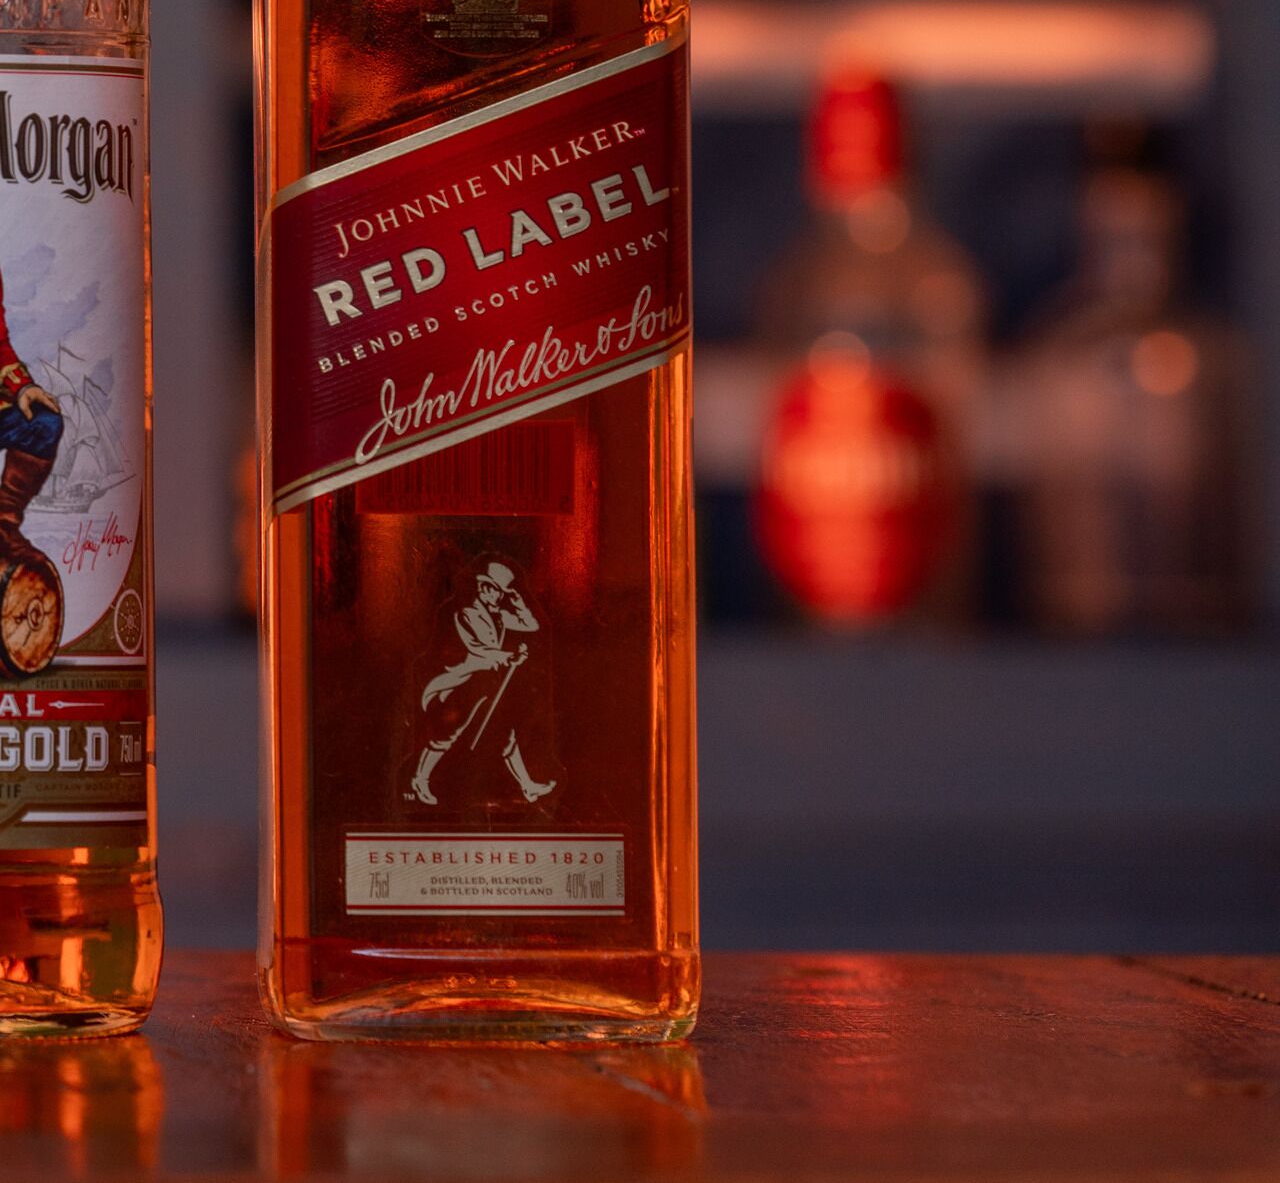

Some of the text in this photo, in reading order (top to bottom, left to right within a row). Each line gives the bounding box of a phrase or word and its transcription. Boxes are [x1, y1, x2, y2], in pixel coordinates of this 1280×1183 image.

[334, 121, 638, 258] JOHNNIE WALKER
[312, 164, 672, 327] RED LABEL
[317, 229, 671, 374] BLENDED SCOTCH WHISKY
[354, 372, 454, 465] John
[452, 325, 597, 414] Walker
[369, 851, 605, 864] ESTABLISHED 1820
[369, 872, 390, 899] 75cl
[430, 887, 479, 895] BOTTLED
[496, 887, 553, 896] SCOTLAND
[491, 876, 543, 885] BLENDED
[565, 872, 587, 899] 40%
[590, 872, 605, 898] vol
